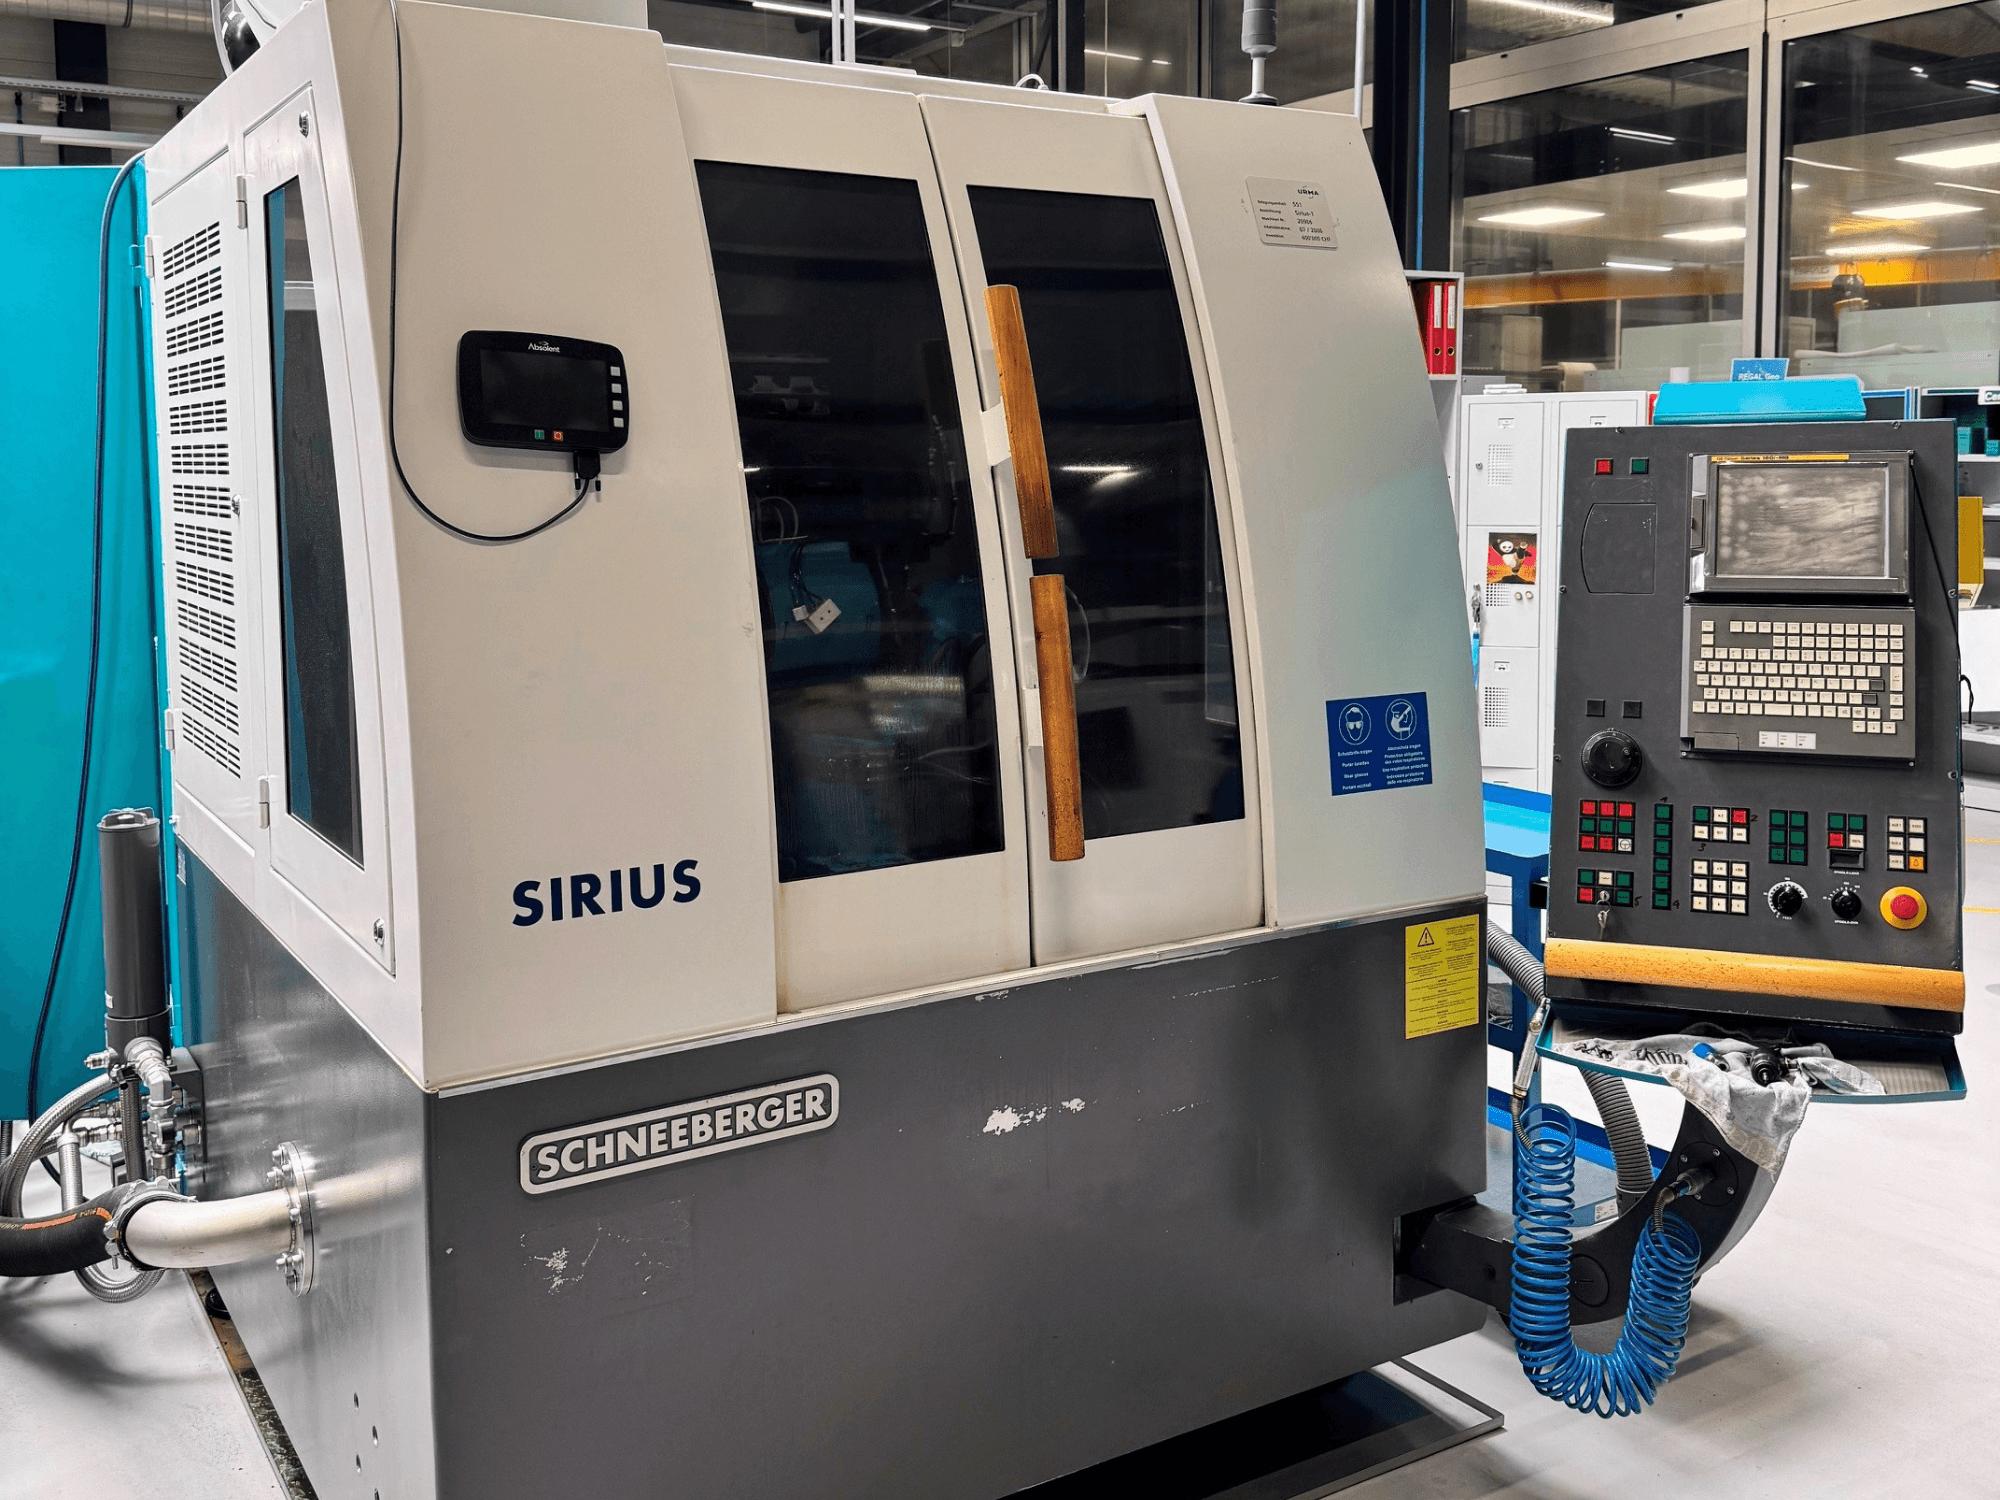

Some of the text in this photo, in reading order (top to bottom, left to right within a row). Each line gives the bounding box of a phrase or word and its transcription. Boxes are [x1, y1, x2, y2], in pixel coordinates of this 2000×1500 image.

[528, 343, 560, 353] Absolent
[1738, 372, 1763, 381] REGAL
[1750, 814, 1758, 822] 2
[1698, 843, 1706, 851] 3
[512, 859, 701, 927] SIRIUS
[1672, 899, 1680, 909] 4
[537, 1088, 828, 1179] SCHNEEBERGER
